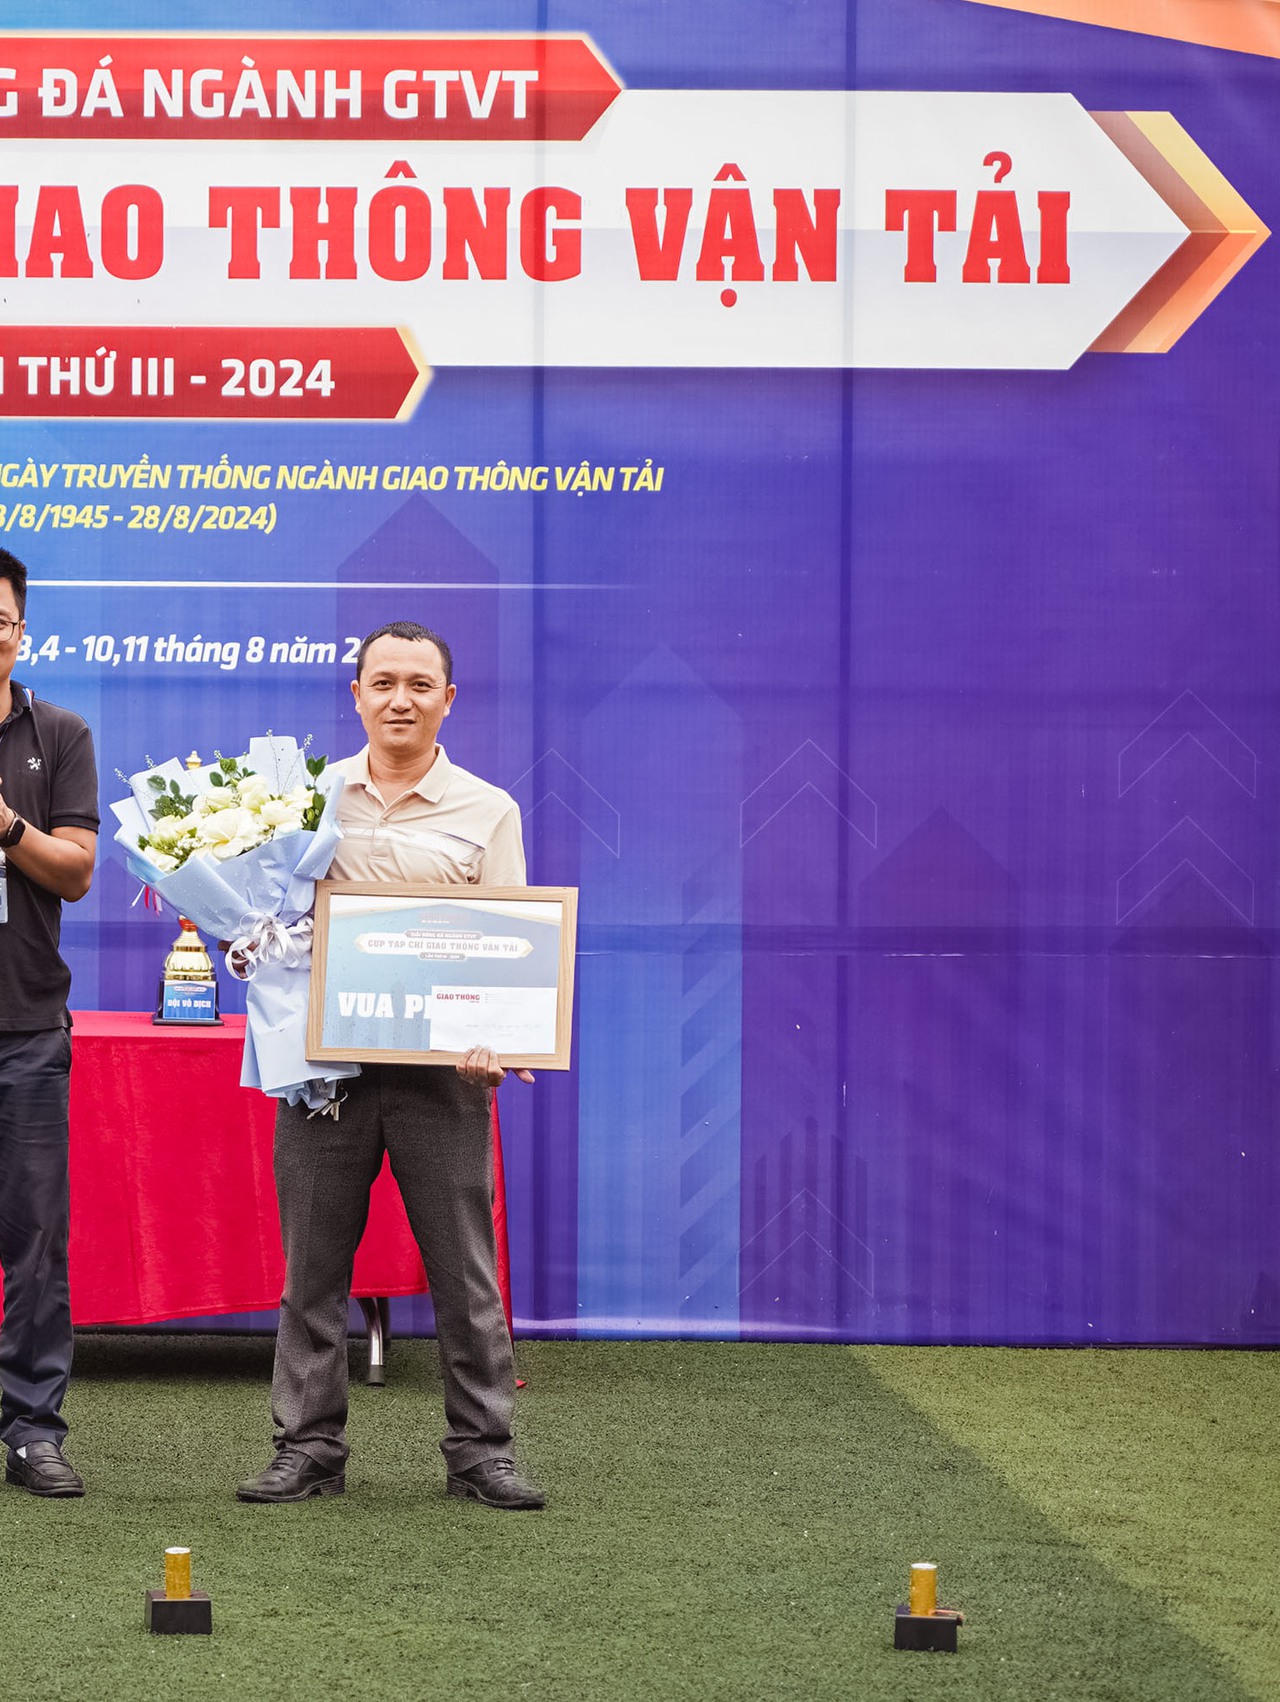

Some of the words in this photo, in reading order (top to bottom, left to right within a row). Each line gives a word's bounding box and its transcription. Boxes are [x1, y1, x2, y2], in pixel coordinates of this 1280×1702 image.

[38, 54, 124, 117] ĐÁ
[143, 55, 362, 119] NGÀNH
[383, 69, 539, 119] GTVT
[208, 160, 582, 282] THÔNG
[625, 163, 841, 308] VẬN
[885, 151, 1071, 284] TẢI
[18, 346, 117, 397] THỨ
[132, 357, 174, 396] III
[190, 375, 206, 384] -
[221, 358, 335, 397] 2024
[62, 453, 171, 489] TRUYỀN
[177, 453, 271, 489] THỐNG
[276, 459, 378, 490] NGÀNH
[382, 465, 449, 491] GIAO
[454, 460, 549, 491] THÔNG
[555, 460, 614, 496] VẬN
[620, 459, 664, 491] TẢI
[128, 502, 277, 535] 28/8/2024)
[82, 635, 149, 667] 10,11
[153, 633, 241, 671] tháng
[245, 636, 266, 664] 8
[269, 635, 337, 664] năm
[337, 991, 395, 1018] VUA
[436, 993, 455, 1001] GIAO
